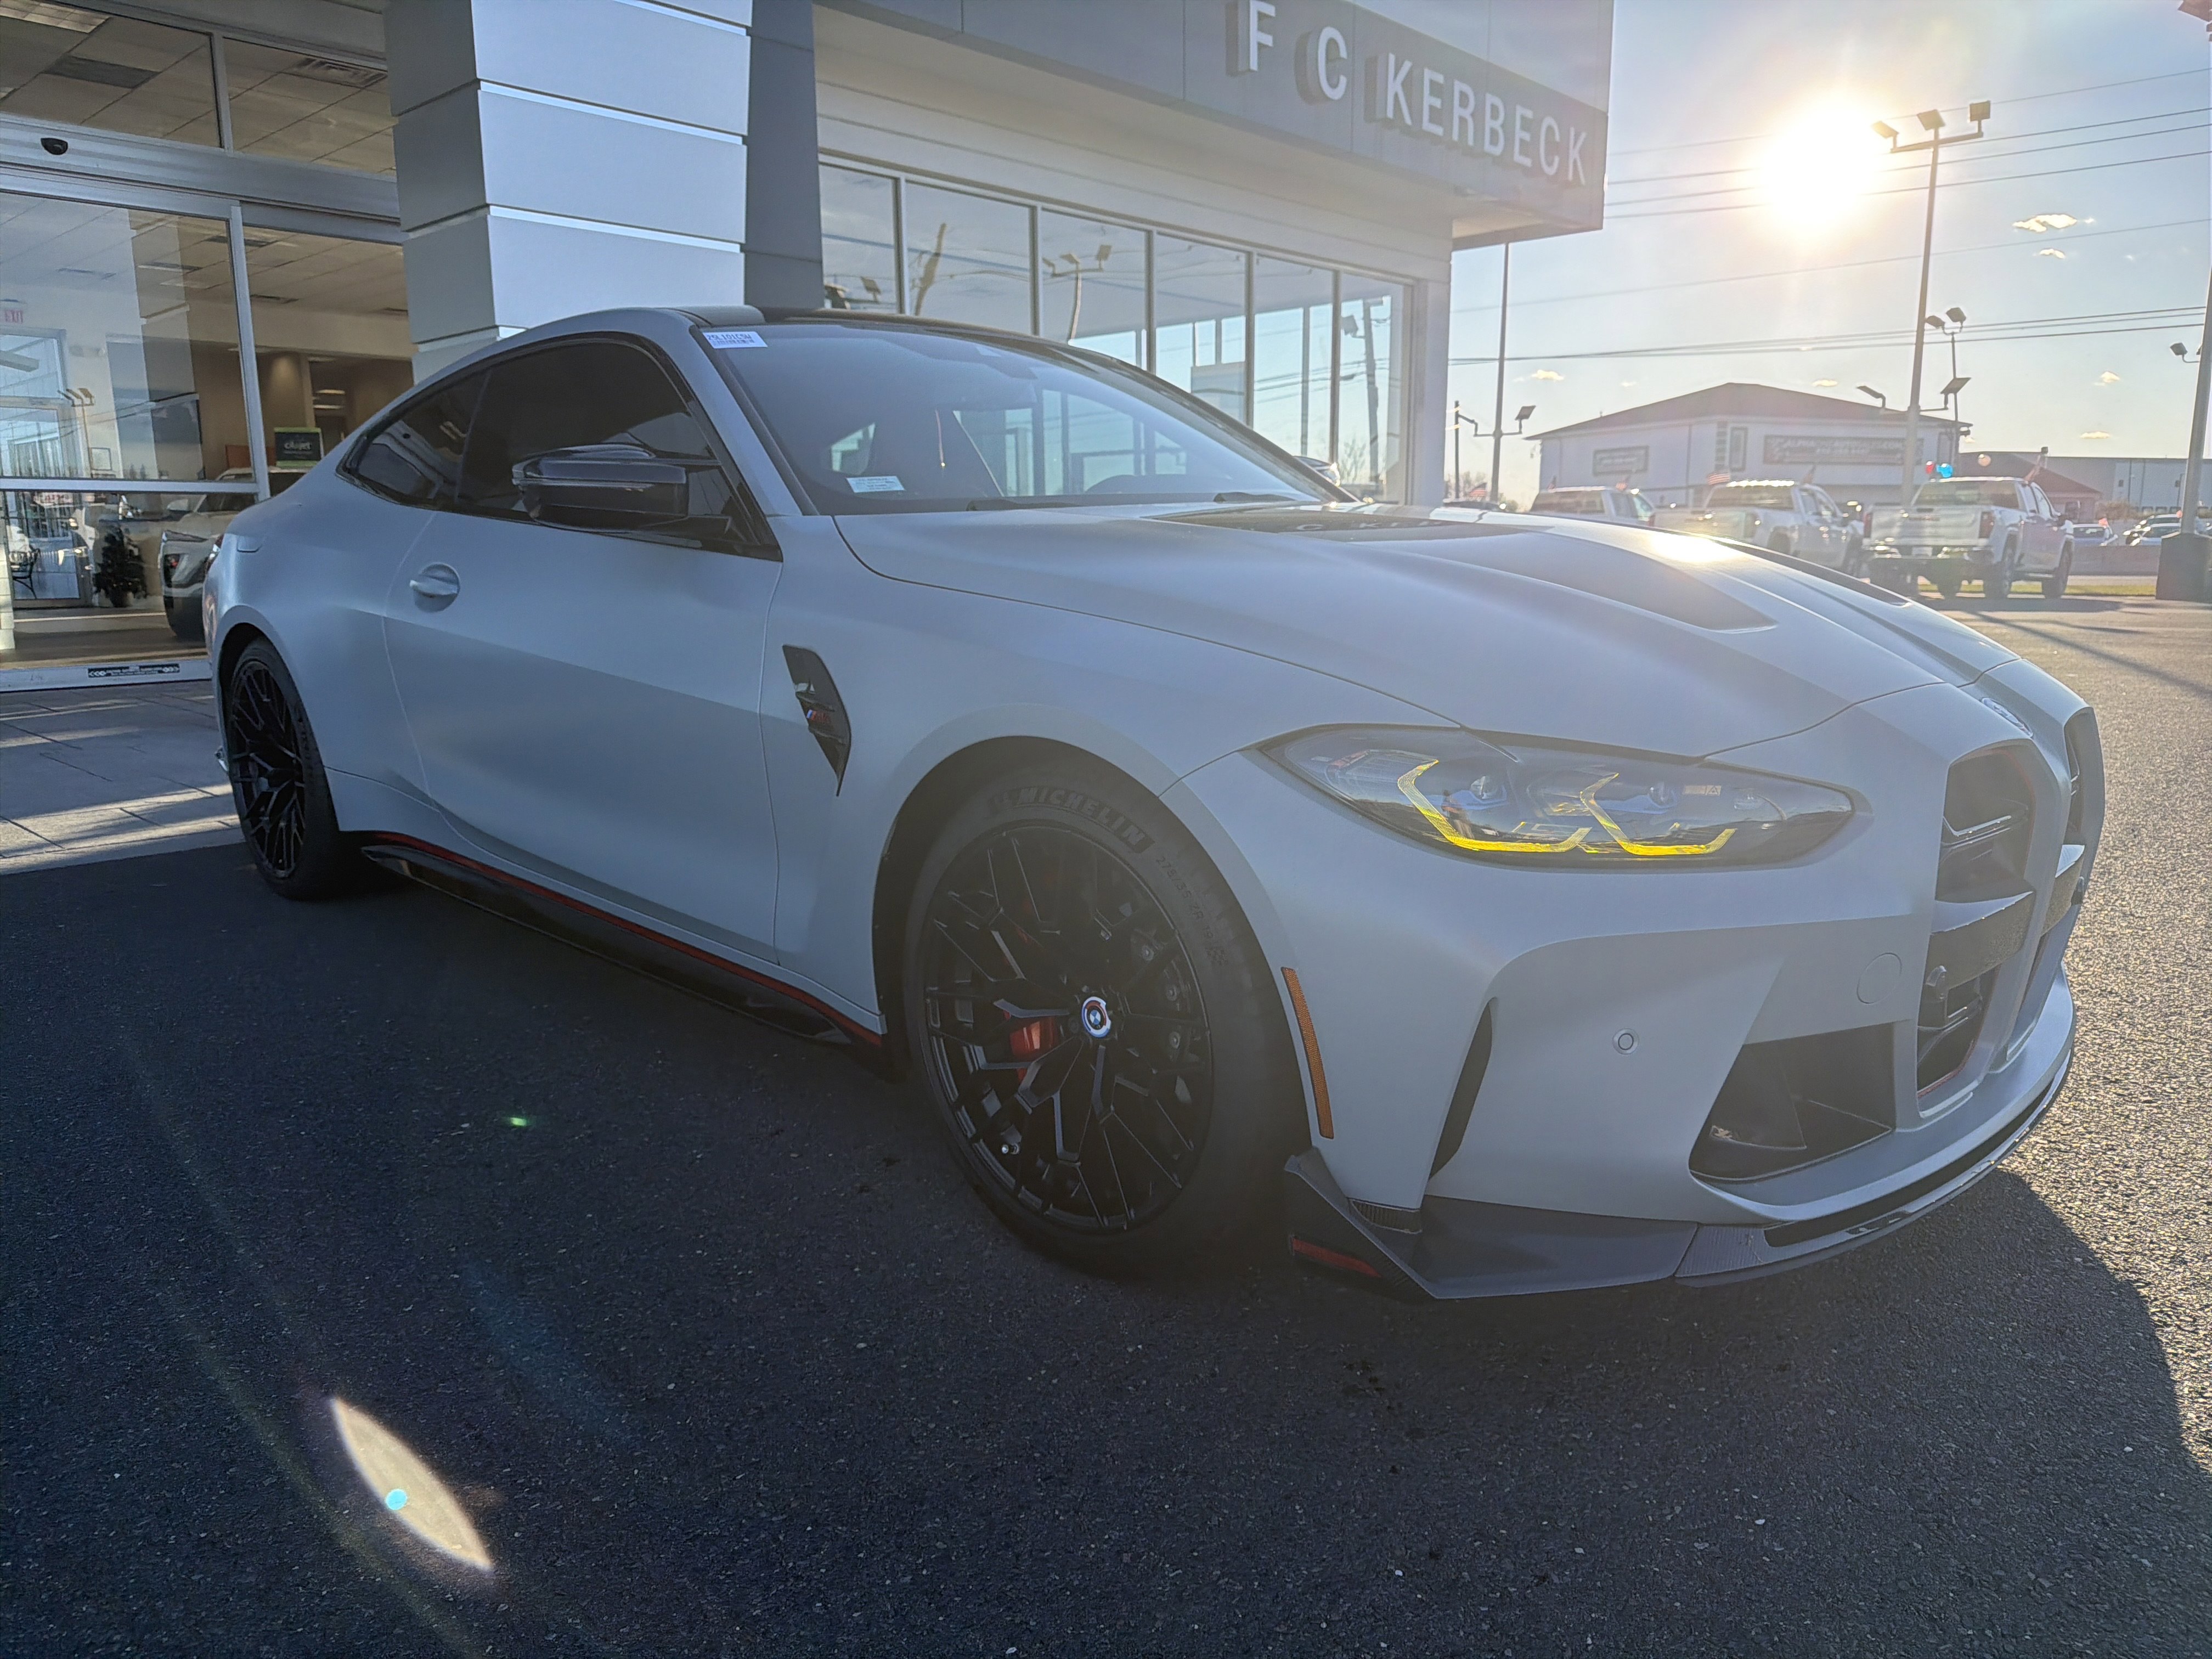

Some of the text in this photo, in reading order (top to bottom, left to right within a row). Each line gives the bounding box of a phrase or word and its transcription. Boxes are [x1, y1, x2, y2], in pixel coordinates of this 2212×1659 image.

[1249, 0, 1588, 186] F C KERBECK
[1016, 787, 1146, 847] MICHELIN
